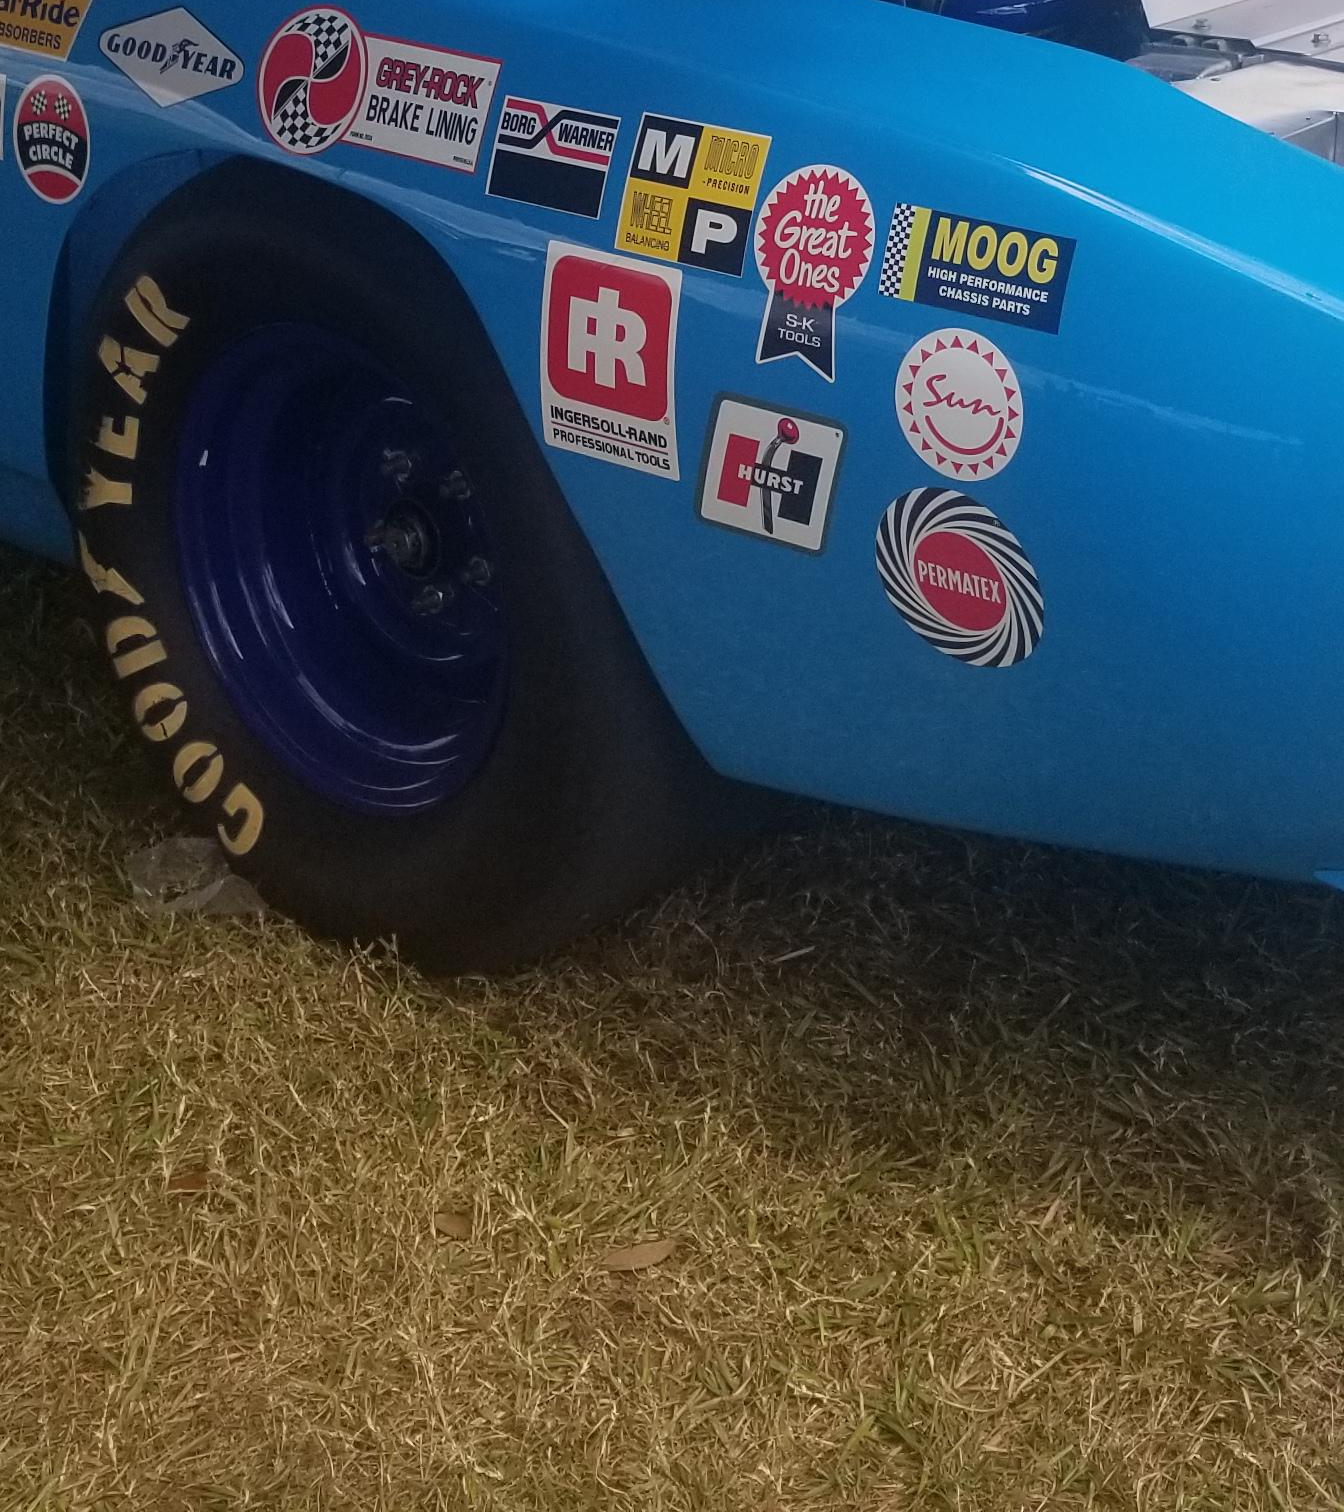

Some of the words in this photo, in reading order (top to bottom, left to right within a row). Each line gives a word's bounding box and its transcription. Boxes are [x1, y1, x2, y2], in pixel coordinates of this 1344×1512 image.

[376, 57, 485, 109] GREY-ROCK
[23, 123, 79, 149] PERFECT
[366, 94, 424, 132] BRAKE
[425, 107, 478, 145] LINING
[501, 112, 537, 135] BORG
[558, 122, 614, 152] WARNER
[29, 144, 74, 170] CIRCLE
[637, 128, 697, 178] M
[704, 136, 759, 179] MICRO
[804, 180, 841, 221] the
[626, 232, 670, 251] BALANCING
[690, 208, 738, 254] P
[774, 210, 857, 260] Great
[931, 217, 1059, 284] MOOG
[779, 248, 840, 293] Ones
[927, 266, 958, 282] HIGH
[959, 273, 1049, 303] PERFORMANCE
[938, 285, 990, 306] CHASSIS
[992, 297, 1031, 316] PARTS
[777, 327, 821, 348] TOOLS
[786, 313, 815, 333] S-K
[923, 374, 1001, 417] Sun
[550, 405, 668, 448] INGERSOLL-RAND
[553, 428, 634, 460] PROFESSIONAL
[634, 450, 670, 470] TOOLS
[737, 464, 804, 495] HURST
[917, 560, 1001, 604] PERMATEX
